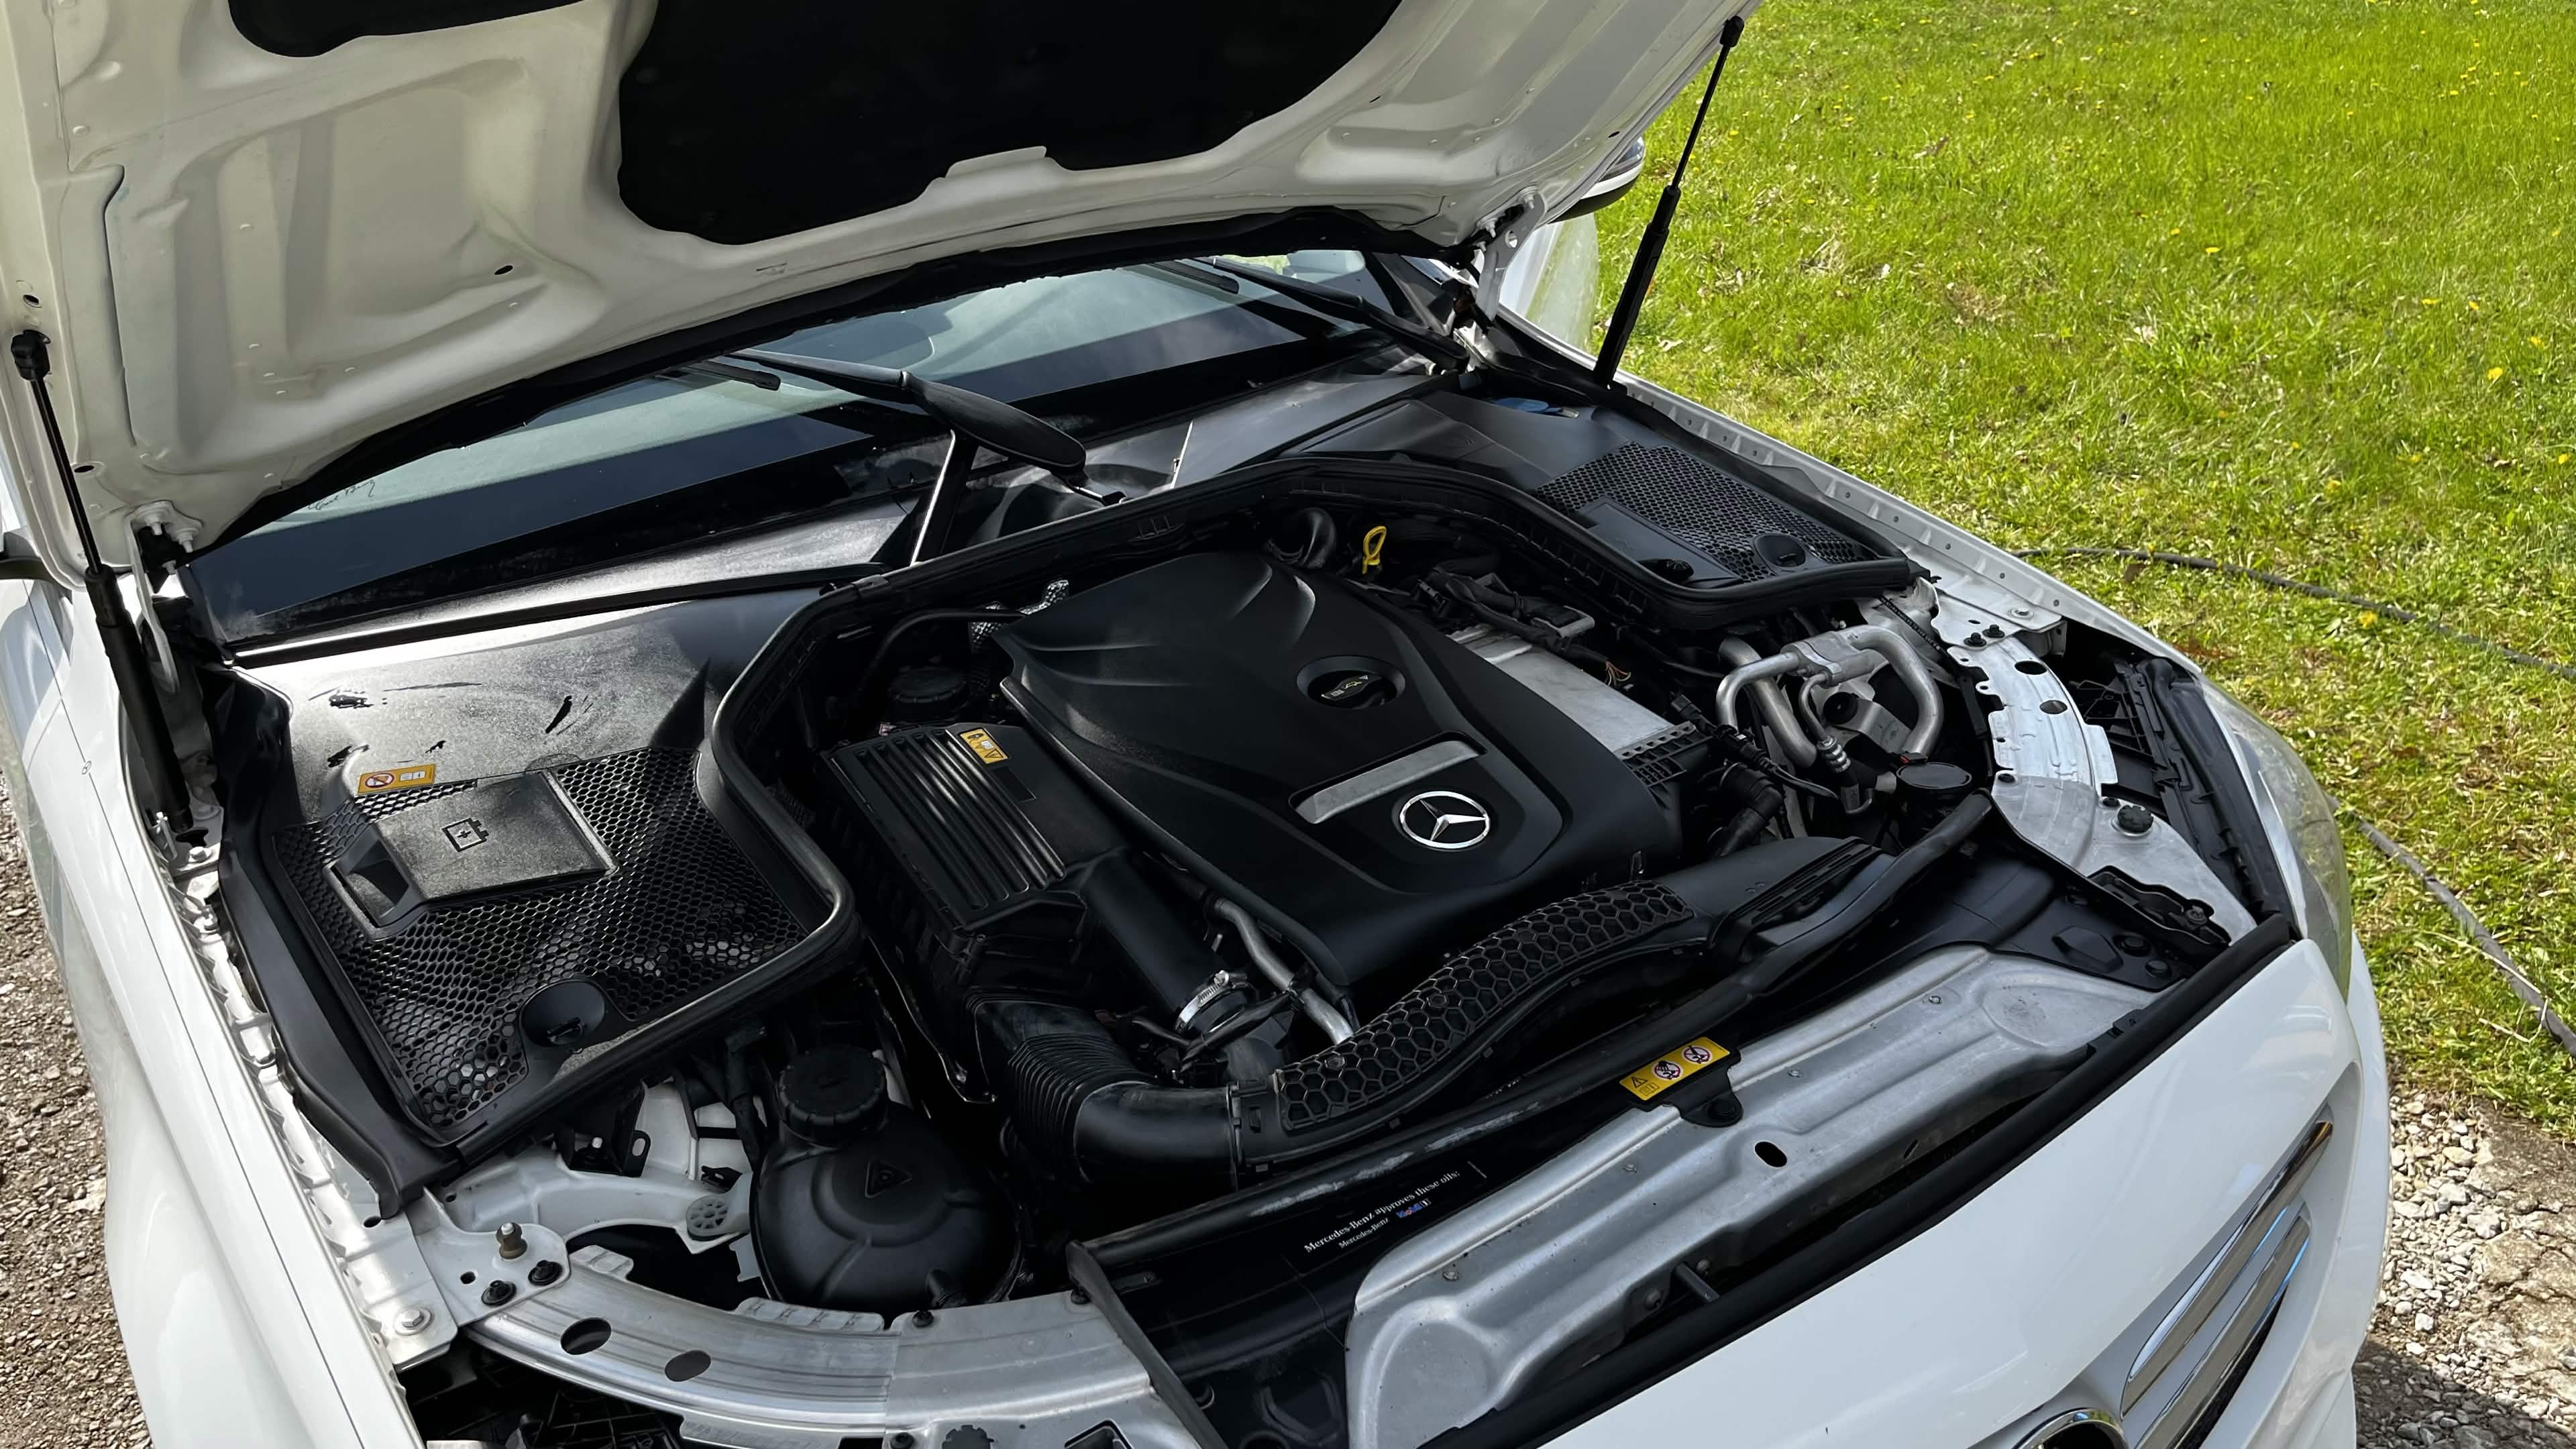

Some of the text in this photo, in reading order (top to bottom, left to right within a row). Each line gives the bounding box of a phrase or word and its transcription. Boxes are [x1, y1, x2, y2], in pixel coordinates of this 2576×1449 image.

[1303, 1212, 1375, 1253] Mercedes-Benz
[1375, 1193, 1415, 1215] approves
[1415, 1179, 1440, 1197] these
[1338, 1217, 1390, 1248] Mercedes-Benz
